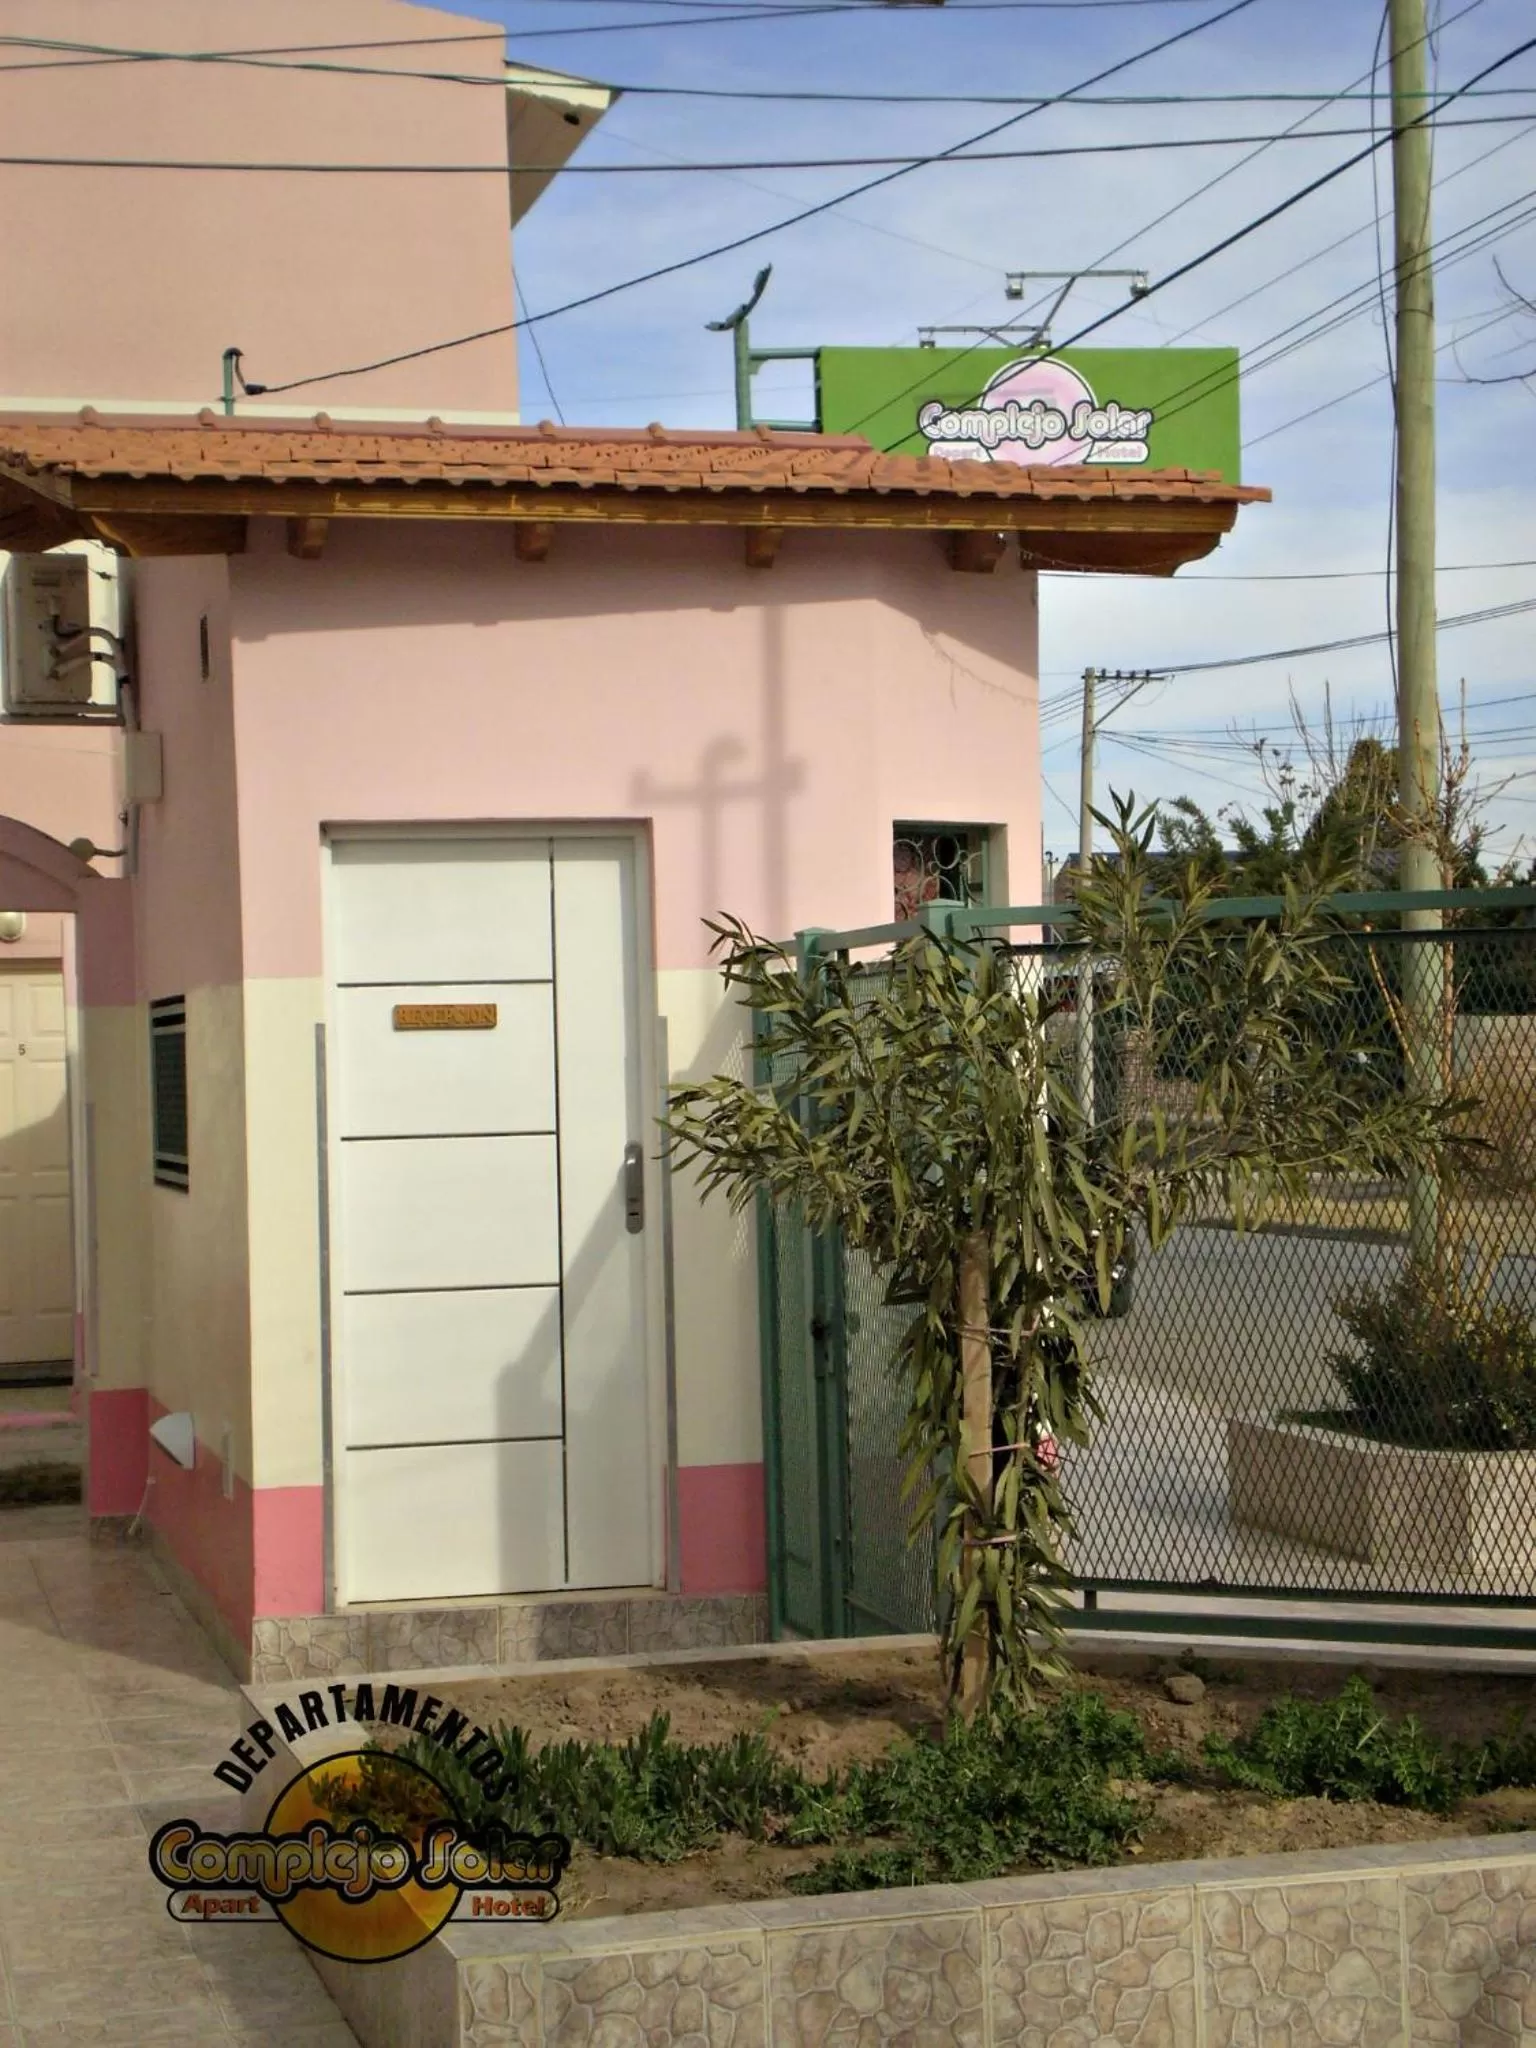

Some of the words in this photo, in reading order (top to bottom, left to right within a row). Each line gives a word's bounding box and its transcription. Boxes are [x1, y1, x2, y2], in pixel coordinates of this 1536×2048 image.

[919, 401, 1065, 447] Complejo
[1070, 401, 1152, 440] Solar
[19, 1043, 26, 1056] 5
